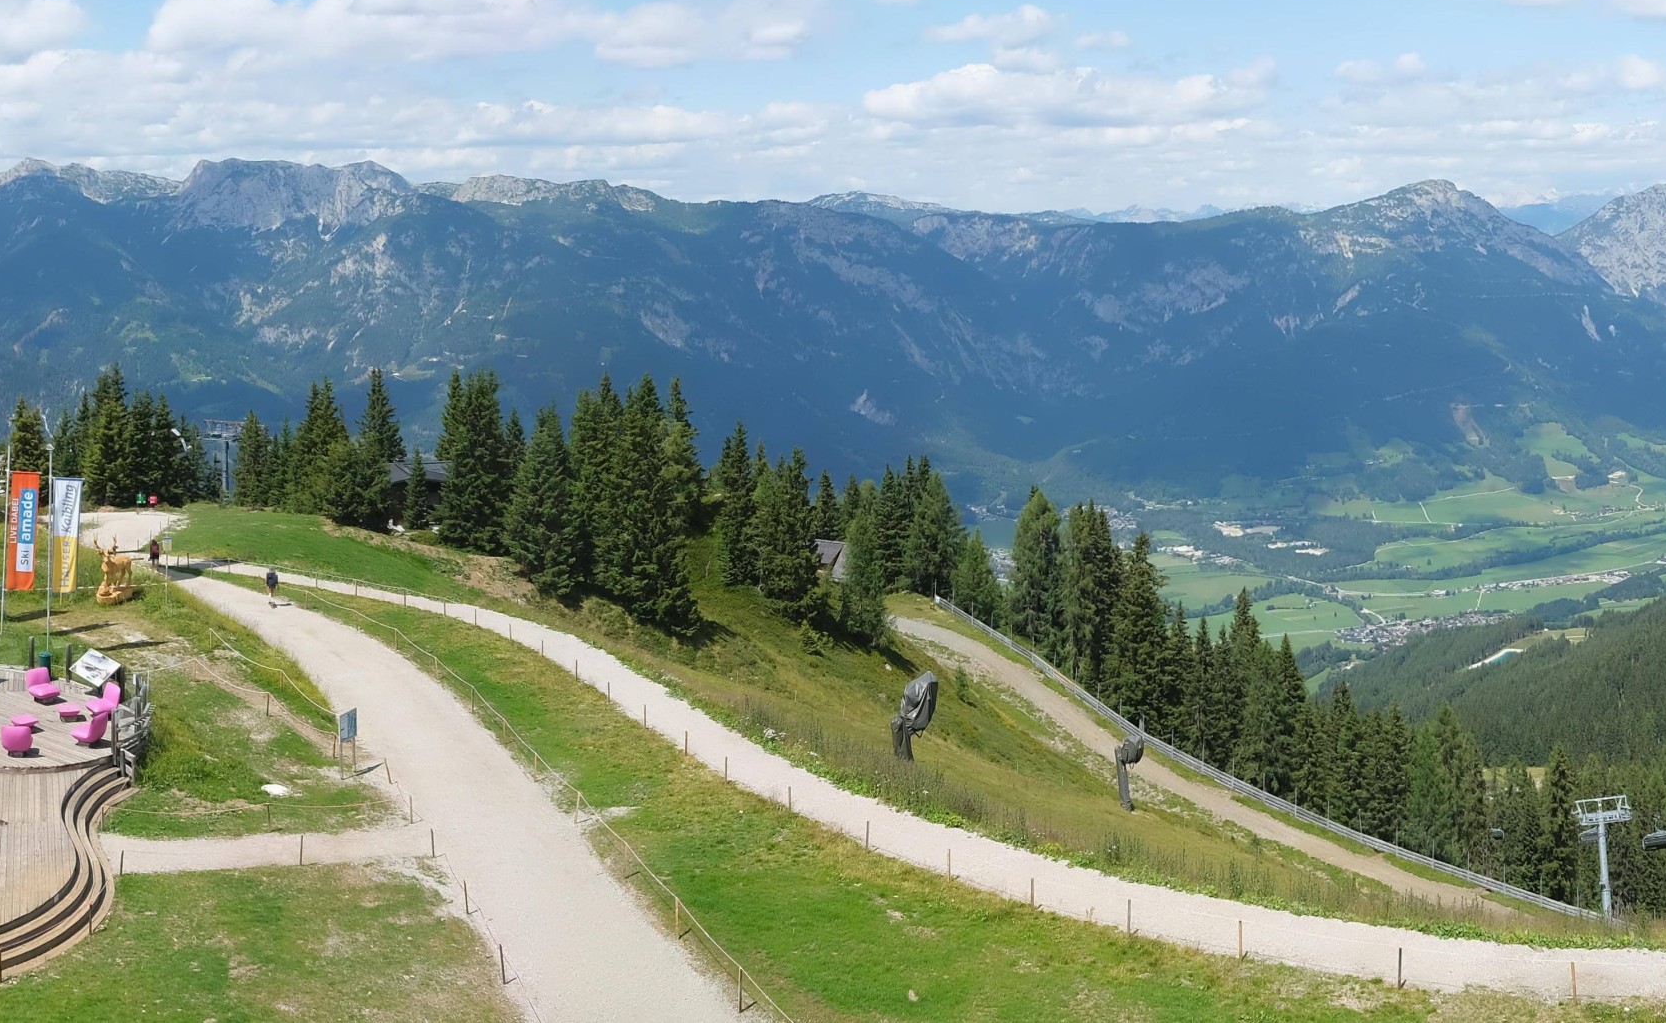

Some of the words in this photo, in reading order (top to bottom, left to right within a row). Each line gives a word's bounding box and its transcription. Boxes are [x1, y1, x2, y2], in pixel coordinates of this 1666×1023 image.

[11, 498, 19, 524] DABEI
[61, 484, 77, 533] Kaibling
[9, 526, 18, 544] LIVE
[21, 550, 30, 565] Ski
[61, 540, 71, 588] HAUSER
